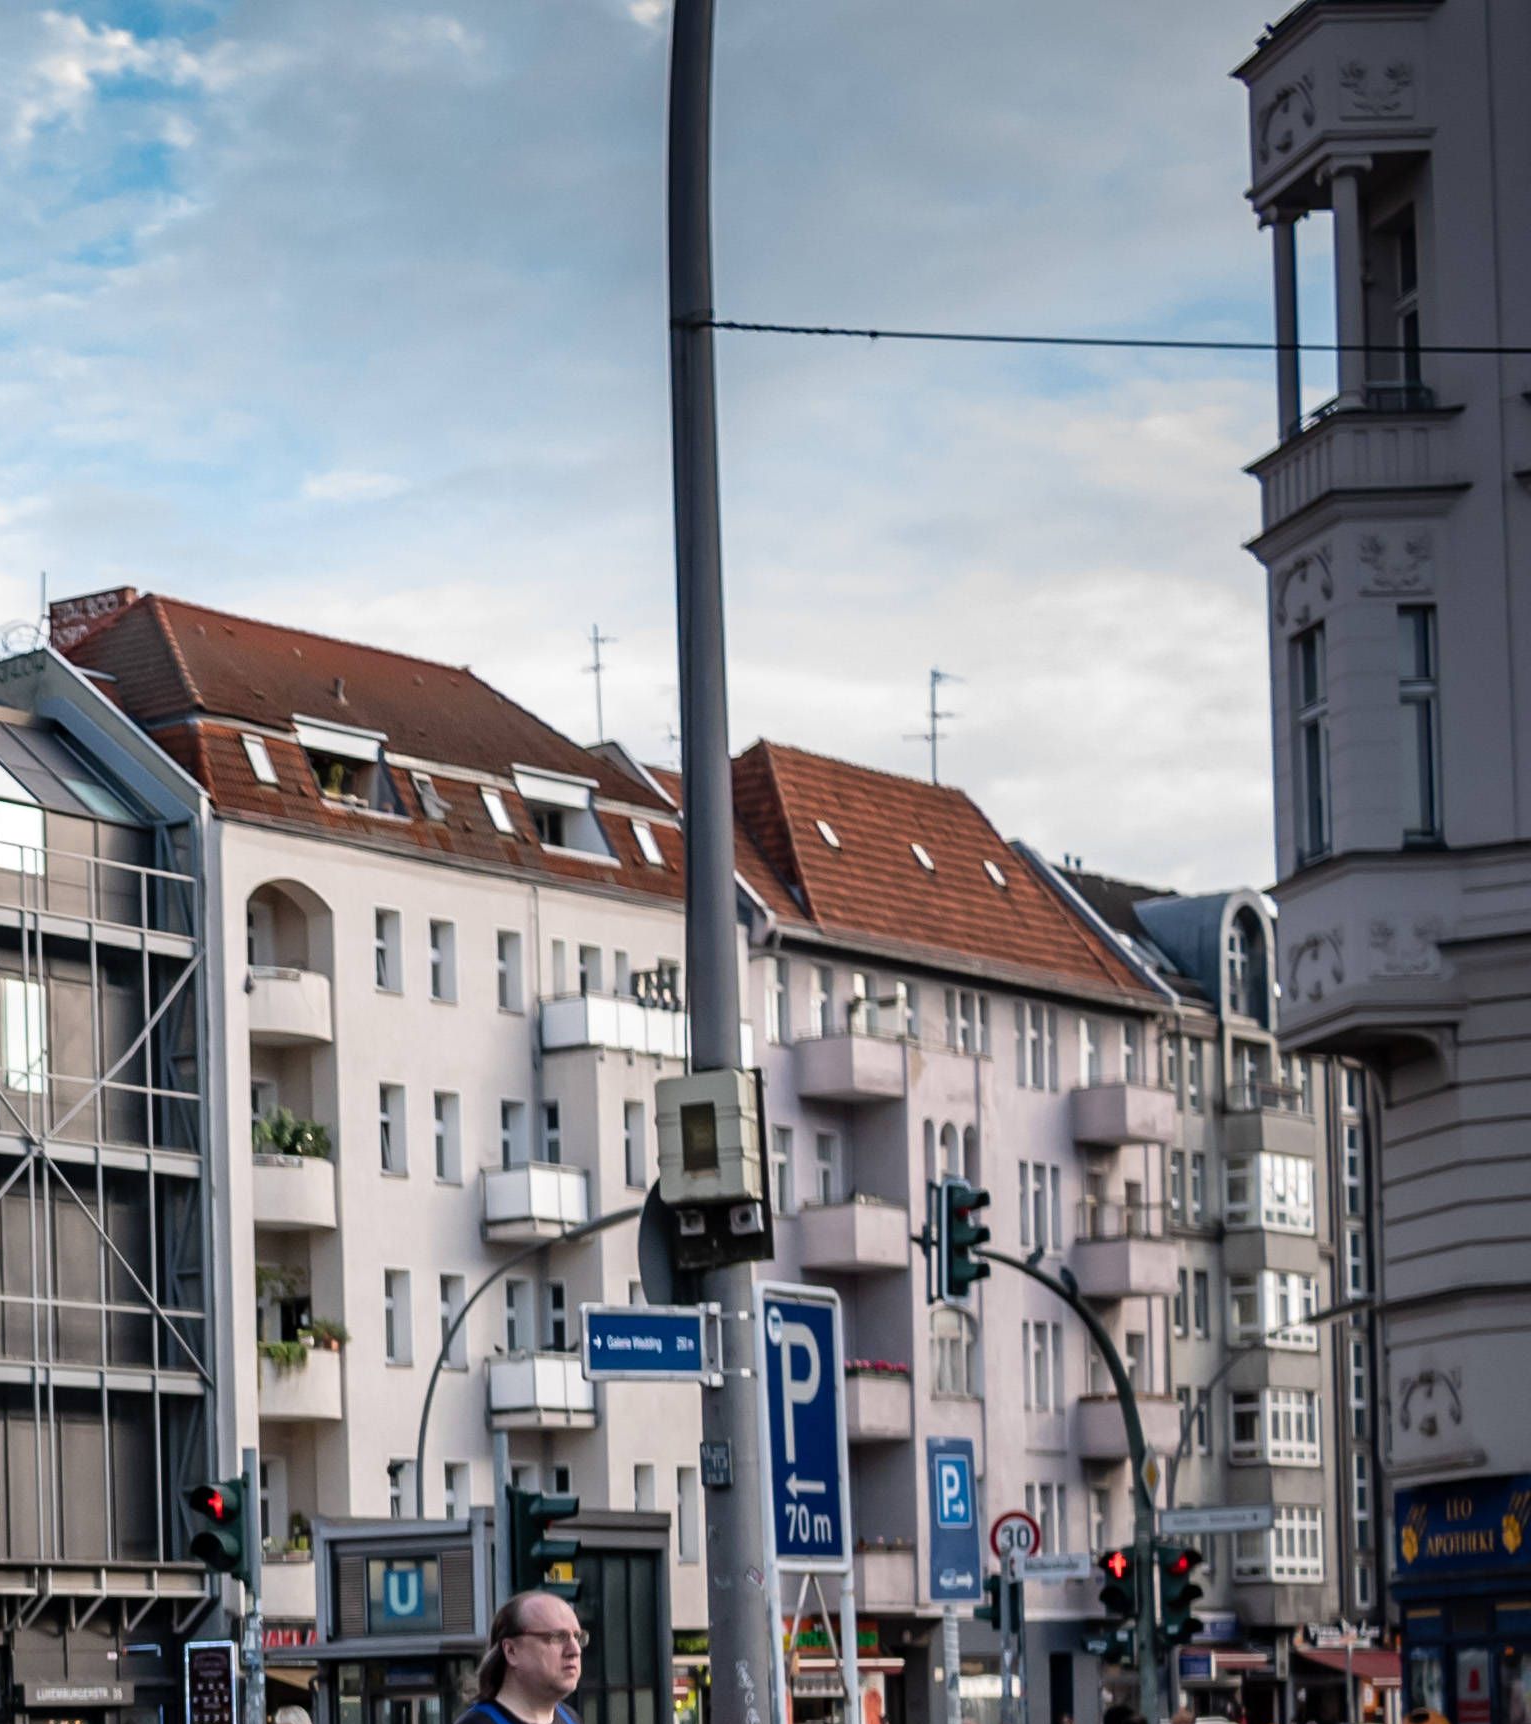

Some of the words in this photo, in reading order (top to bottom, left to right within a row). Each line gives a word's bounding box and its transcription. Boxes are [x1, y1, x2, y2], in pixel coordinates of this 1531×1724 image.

[781, 1322, 821, 1464] P
[942, 1464, 960, 1518] P
[785, 1503, 810, 1544] 70
[814, 1512, 833, 1544] m
[1001, 1525, 1030, 1551] 30
[389, 1573, 418, 1616] U
